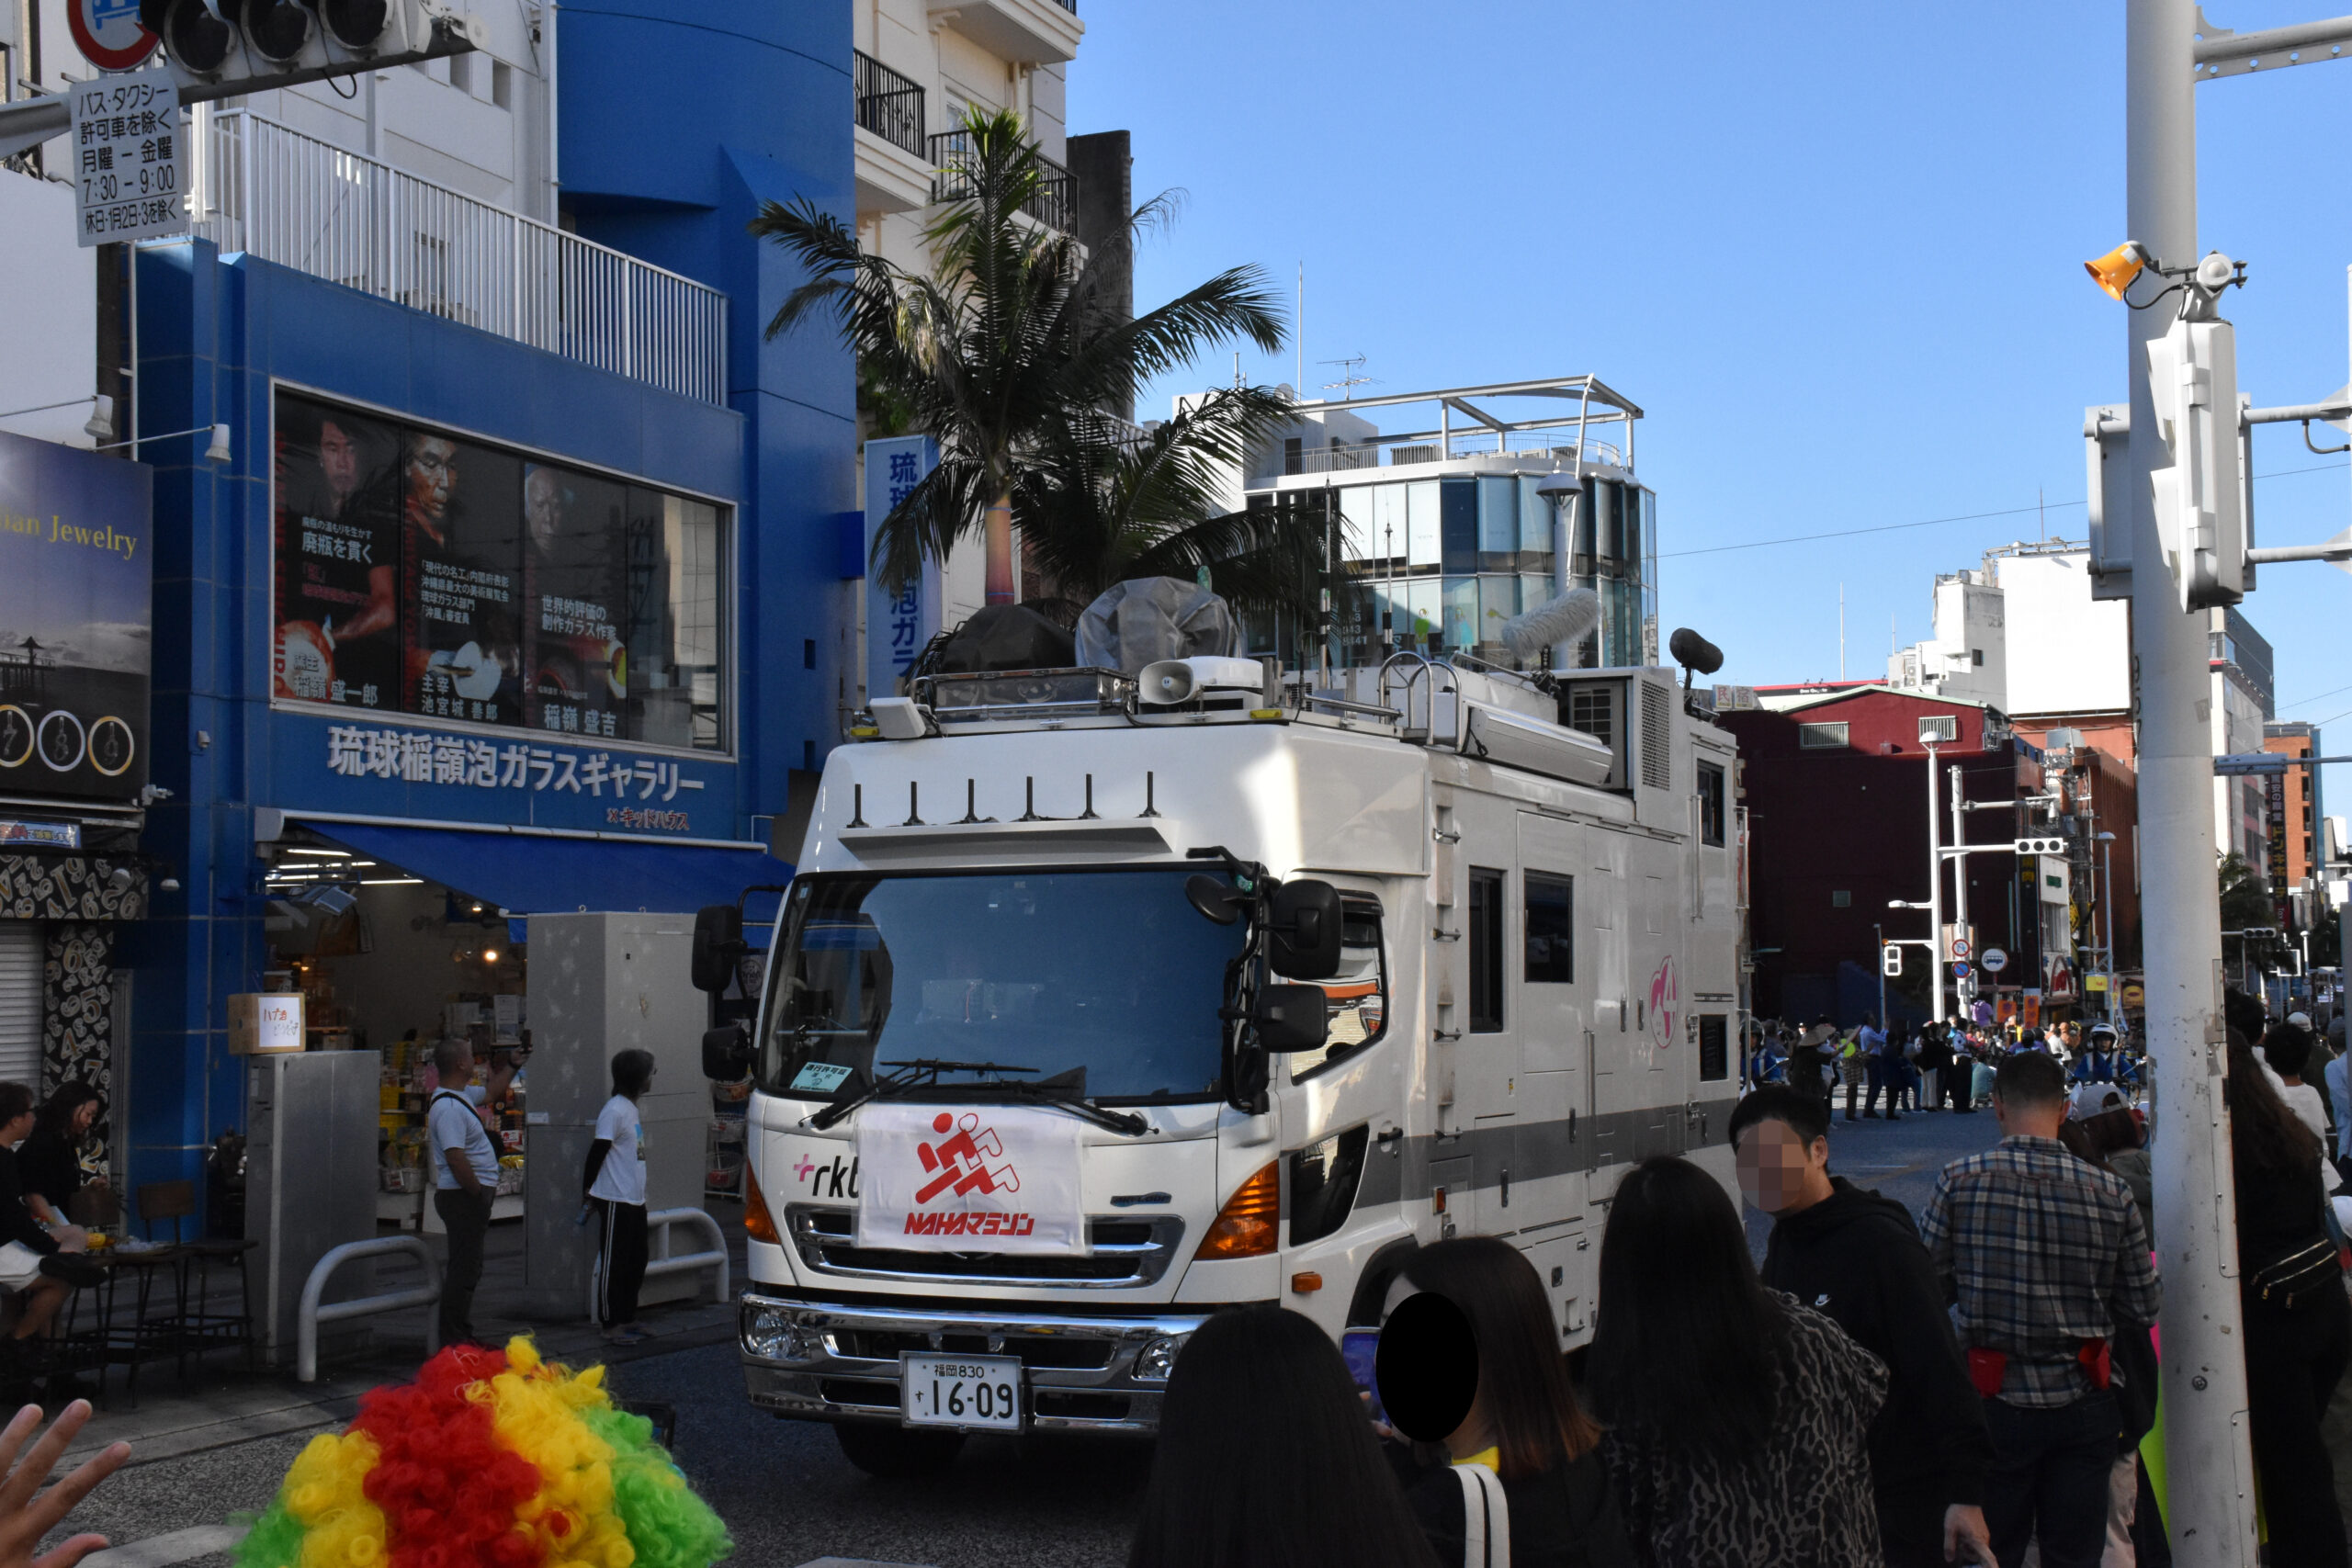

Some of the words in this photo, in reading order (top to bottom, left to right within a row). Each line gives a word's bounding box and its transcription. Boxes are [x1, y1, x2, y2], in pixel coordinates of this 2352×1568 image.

[80, 108, 172, 145] 許可車を除く
[83, 147, 113, 175] 月曜
[141, 136, 173, 164] 金曜
[83, 175, 118, 203] 7:30
[141, 164, 174, 194] 9:00
[49, 515, 138, 560] Jewelry
[542, 594, 606, 622] 世界的評価の
[584, 709, 616, 737] 盛吉
[327, 726, 705, 802] 琉球稲嶺泡ガラスギャラリー
[903, 1212, 1035, 1236] NAHAマラソン
[933, 1380, 1013, 1419] 16-09
